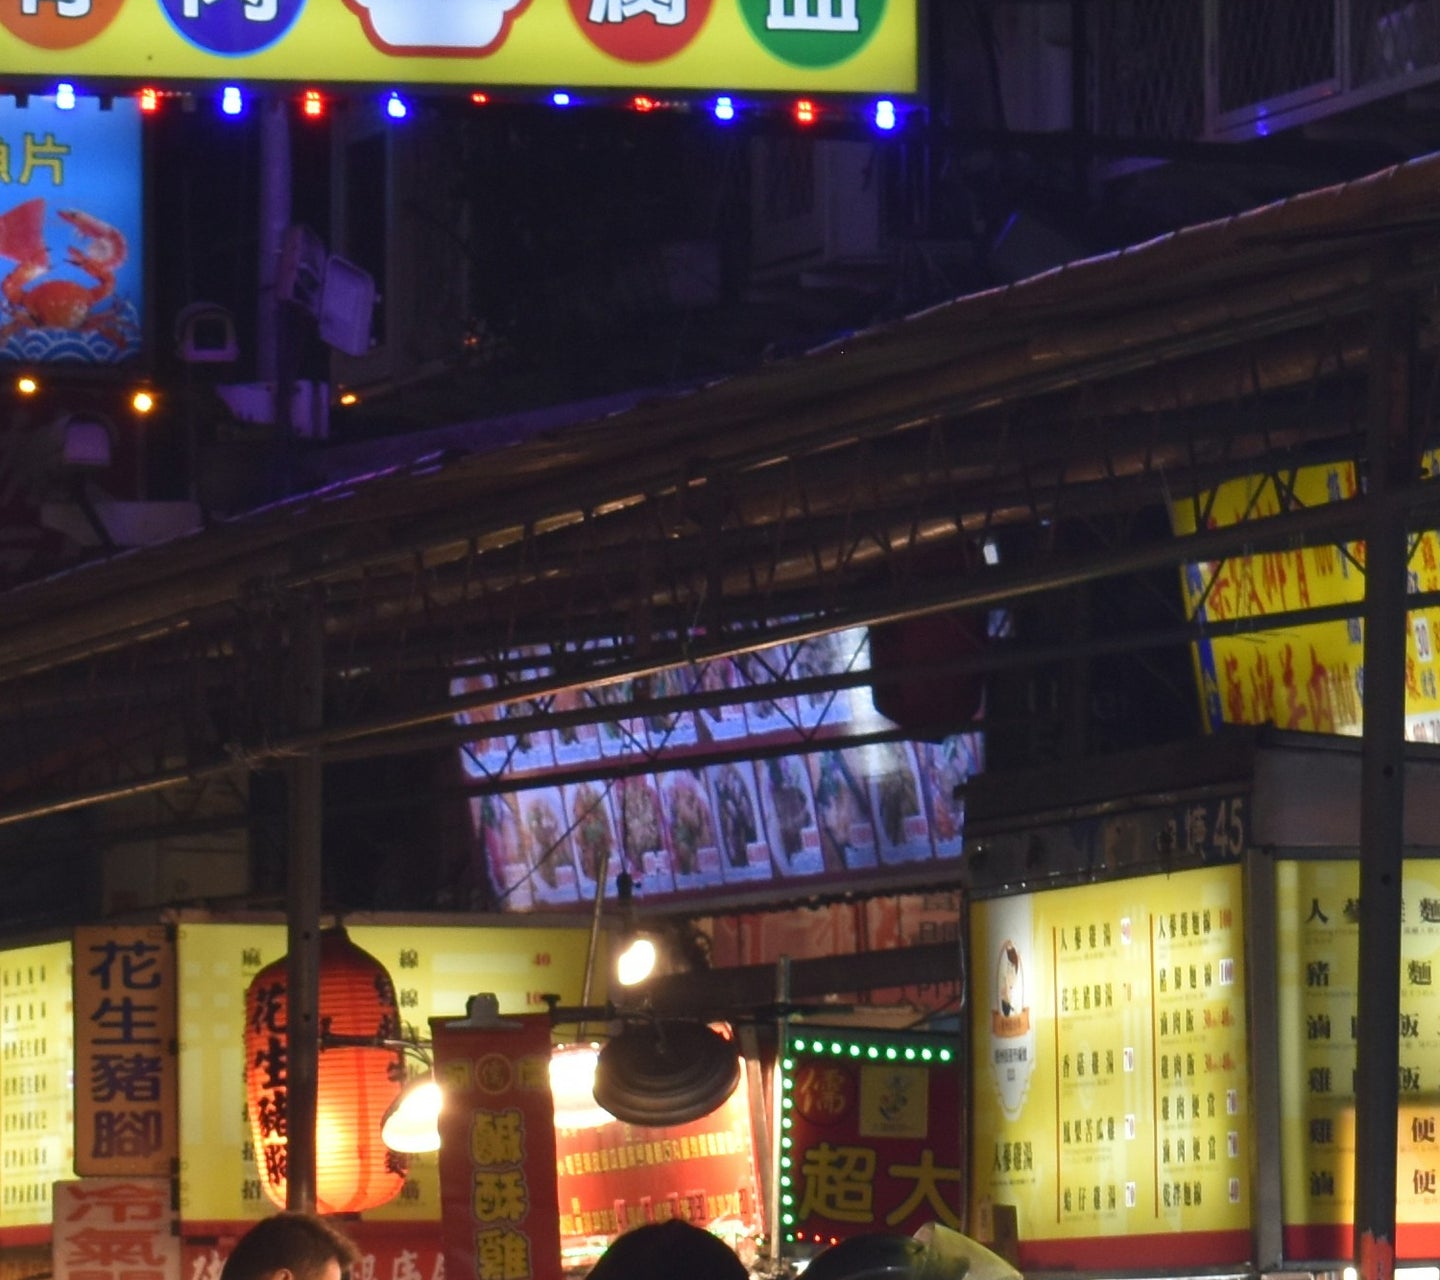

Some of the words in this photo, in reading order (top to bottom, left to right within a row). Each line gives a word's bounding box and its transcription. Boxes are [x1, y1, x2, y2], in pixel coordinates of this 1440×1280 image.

[89, 939, 163, 1160] 花生豬腳
[1306, 1012, 1420, 1041] 滷飯
[1308, 1066, 1421, 1094] 雞飯
[798, 1141, 961, 1231] 超大
